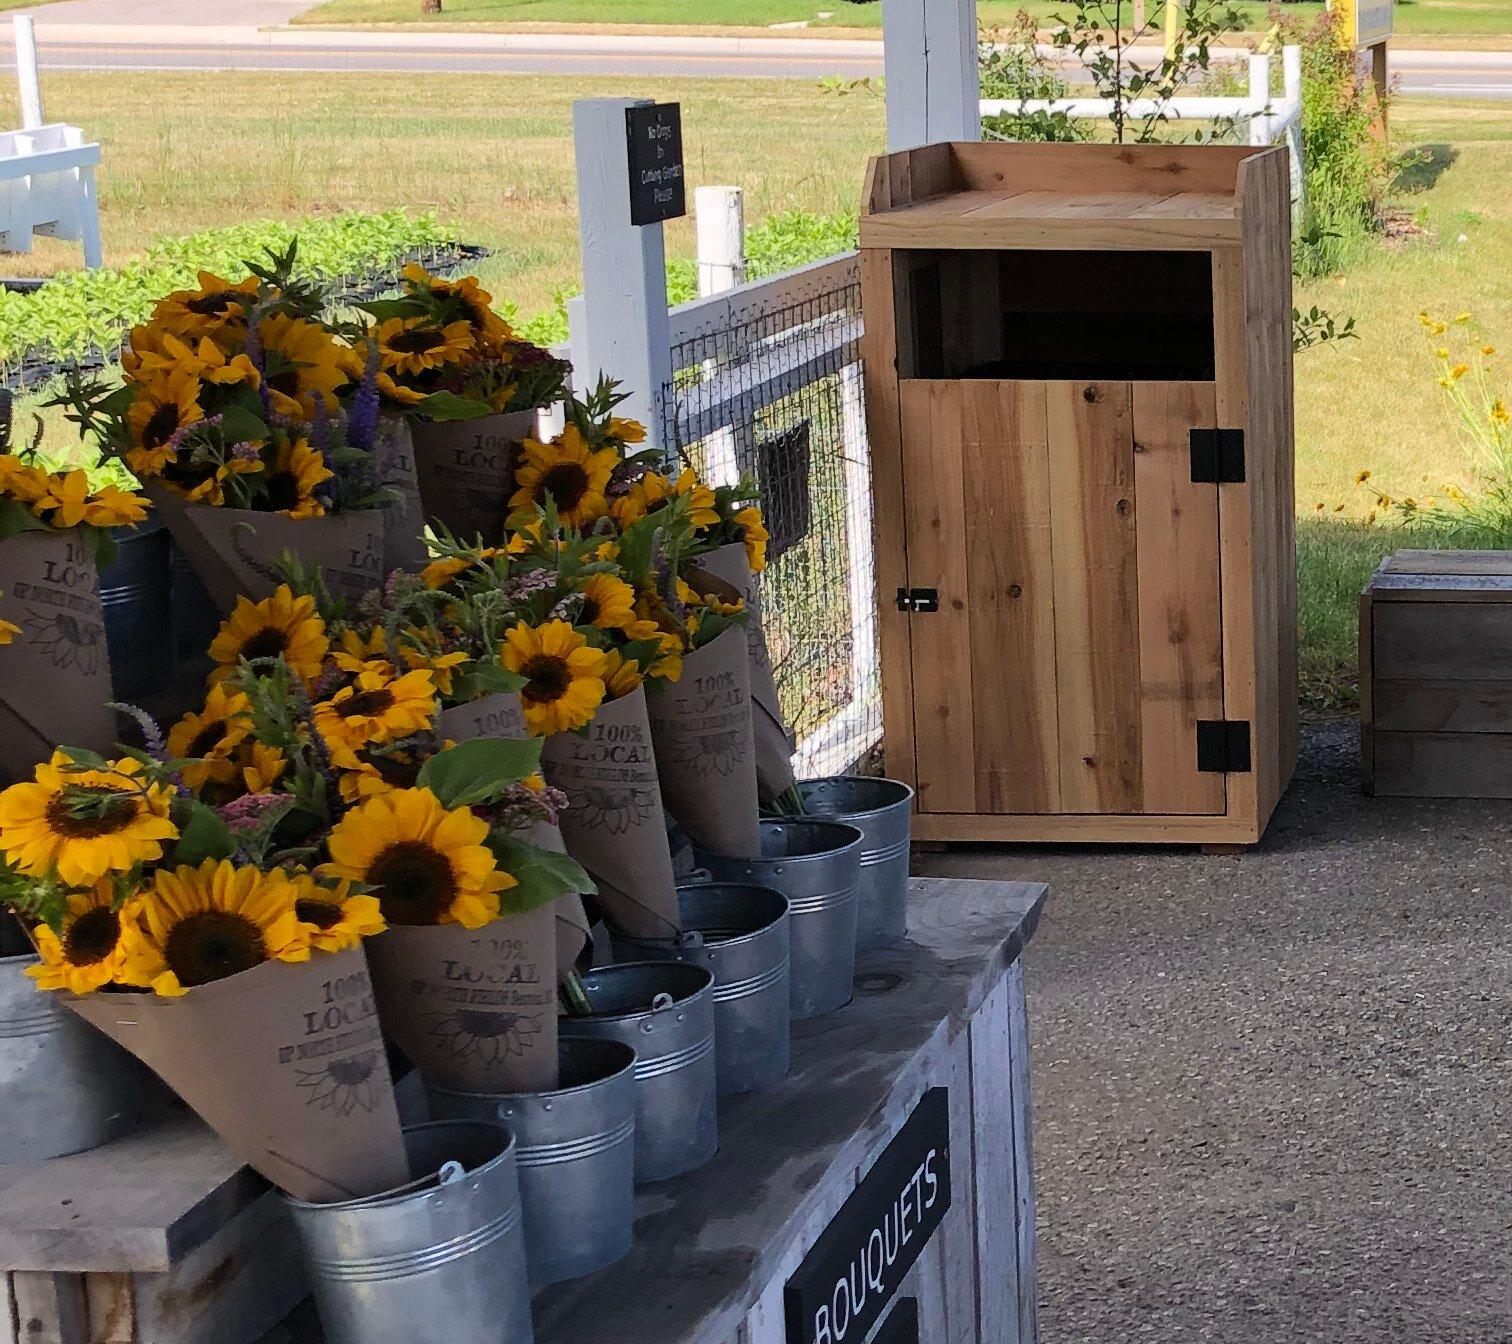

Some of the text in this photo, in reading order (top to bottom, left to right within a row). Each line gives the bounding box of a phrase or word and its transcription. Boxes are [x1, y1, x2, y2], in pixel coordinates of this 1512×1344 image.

[657, 125, 672, 141] Dogs
[595, 723, 642, 743] 100%
[570, 741, 651, 764] LOCAL
